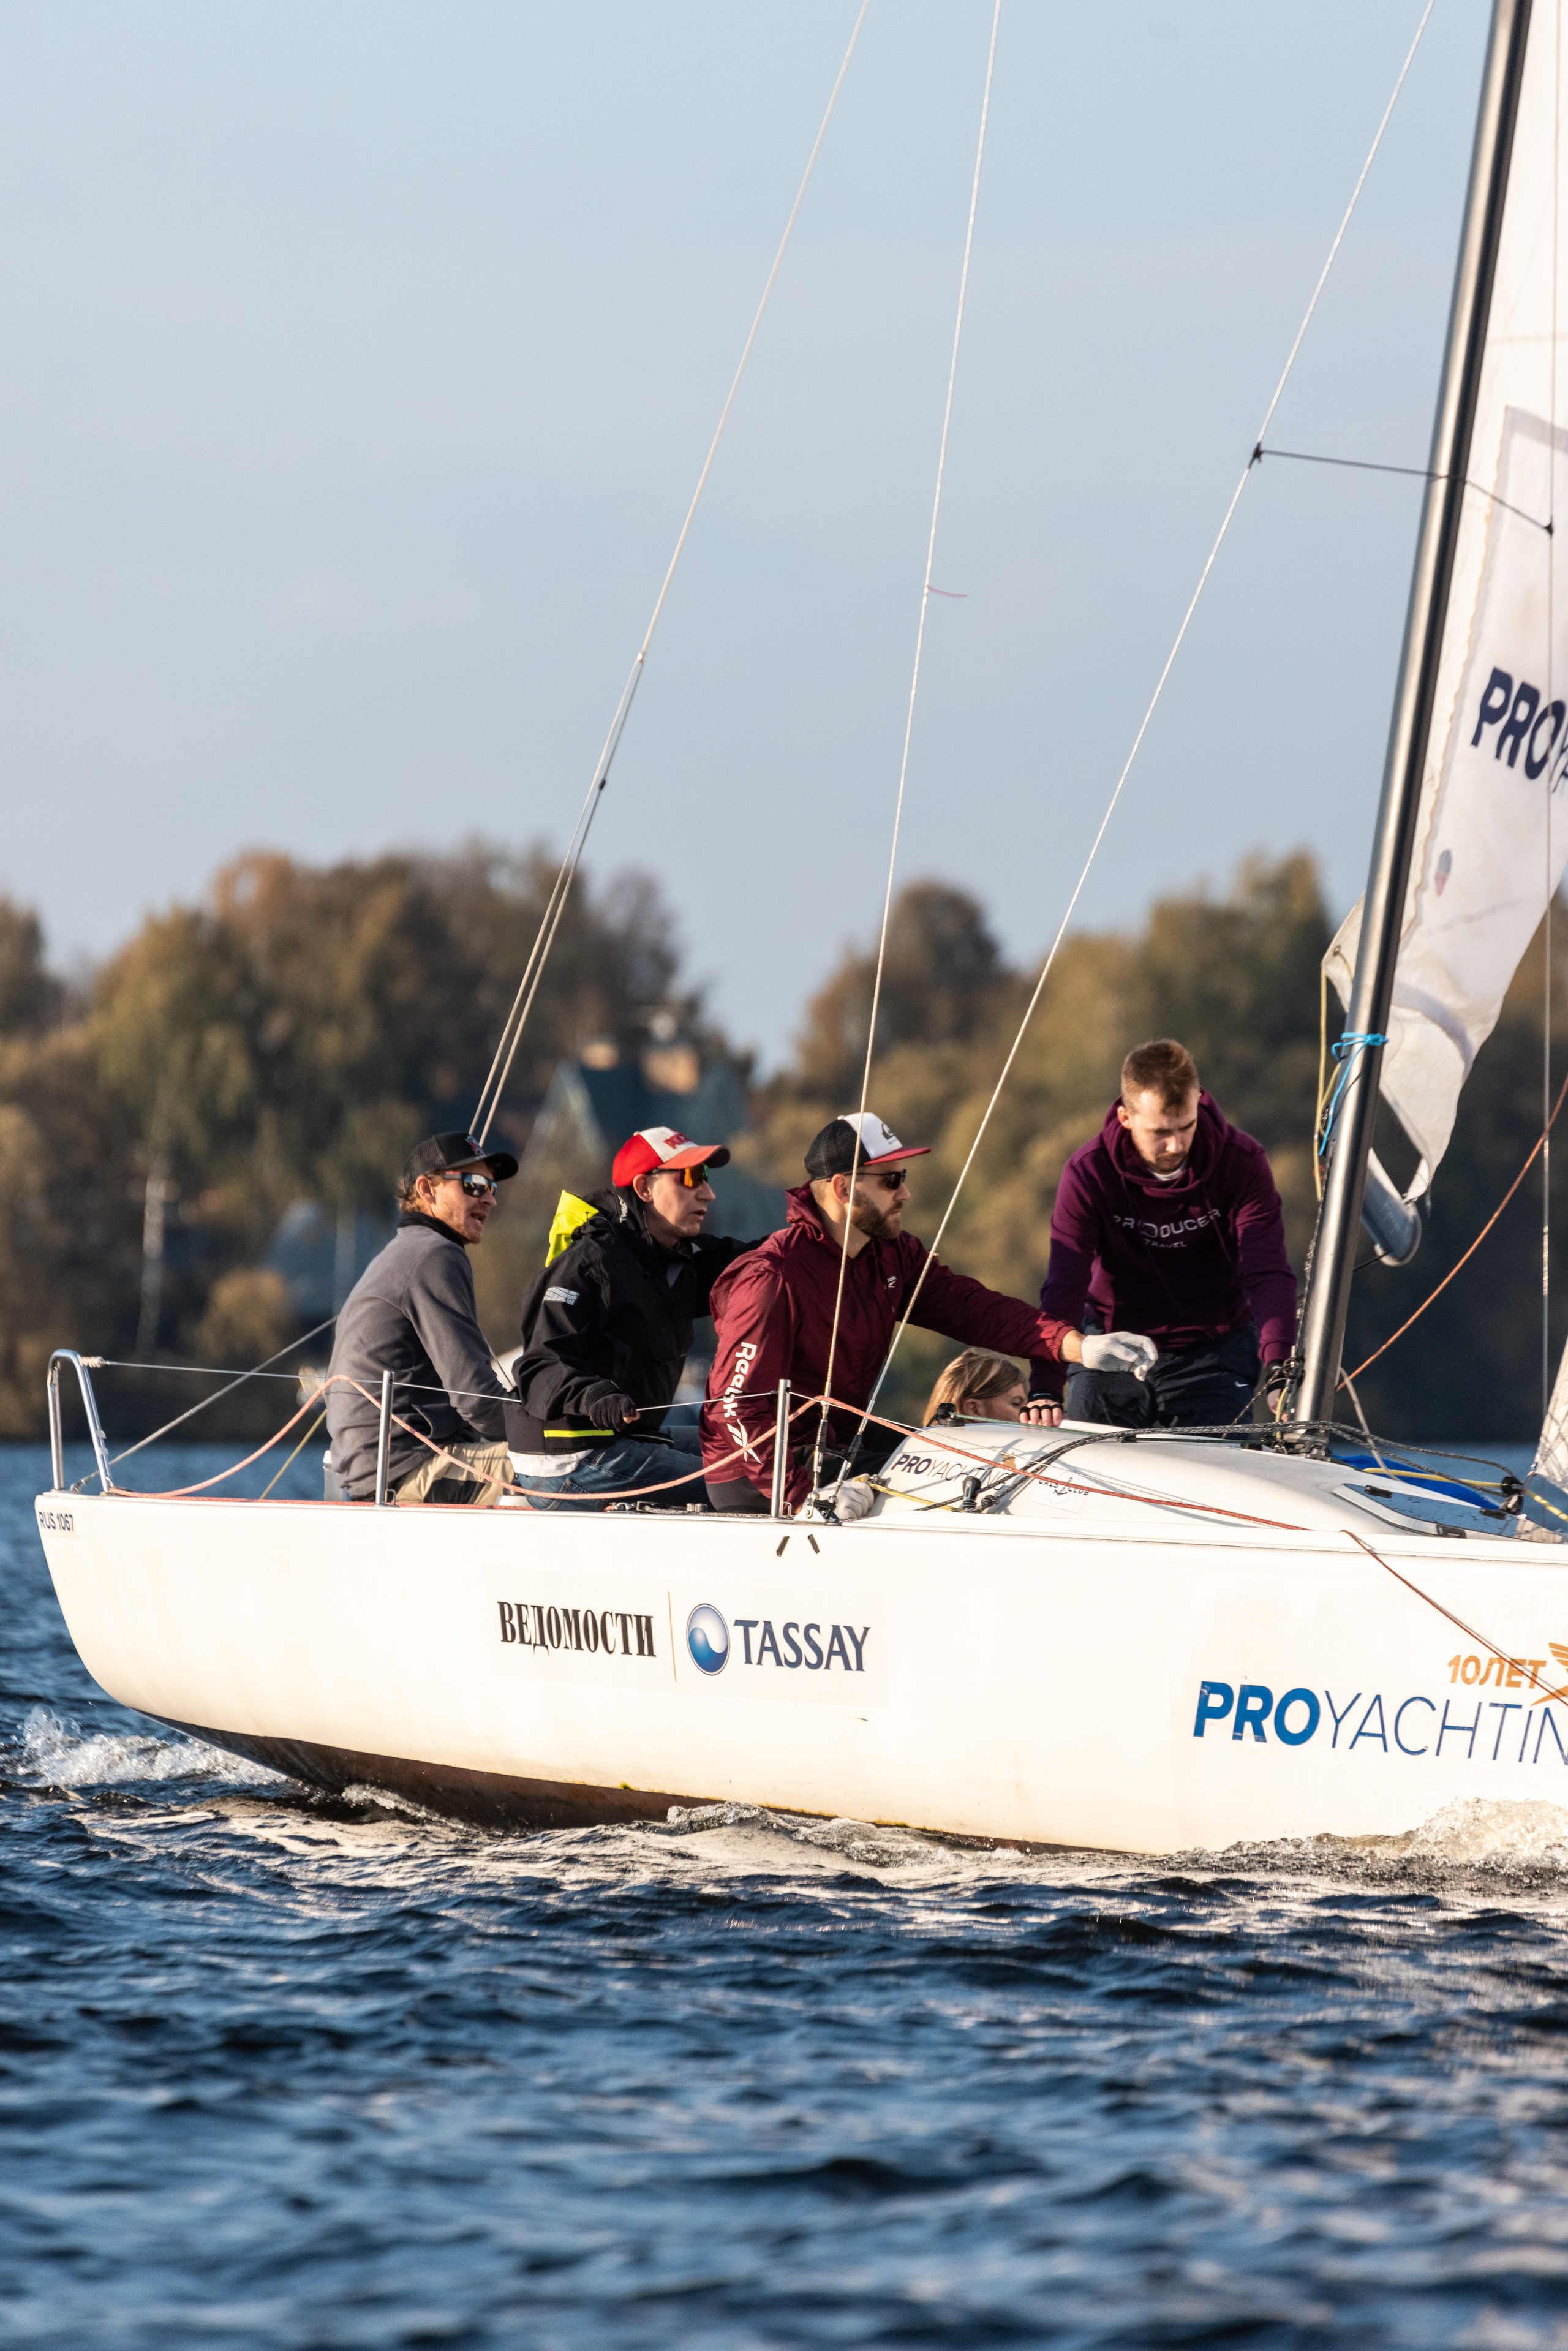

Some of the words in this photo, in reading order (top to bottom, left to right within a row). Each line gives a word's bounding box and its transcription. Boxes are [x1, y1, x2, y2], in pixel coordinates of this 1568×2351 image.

[1144, 1239, 1188, 1248] TRAVEL
[39, 1511, 56, 1530] RUS
[56, 1513, 74, 1531] 1067
[497, 1601, 656, 1658] ВЕДОМОСТИ
[733, 1618, 870, 1672] TASSAY
